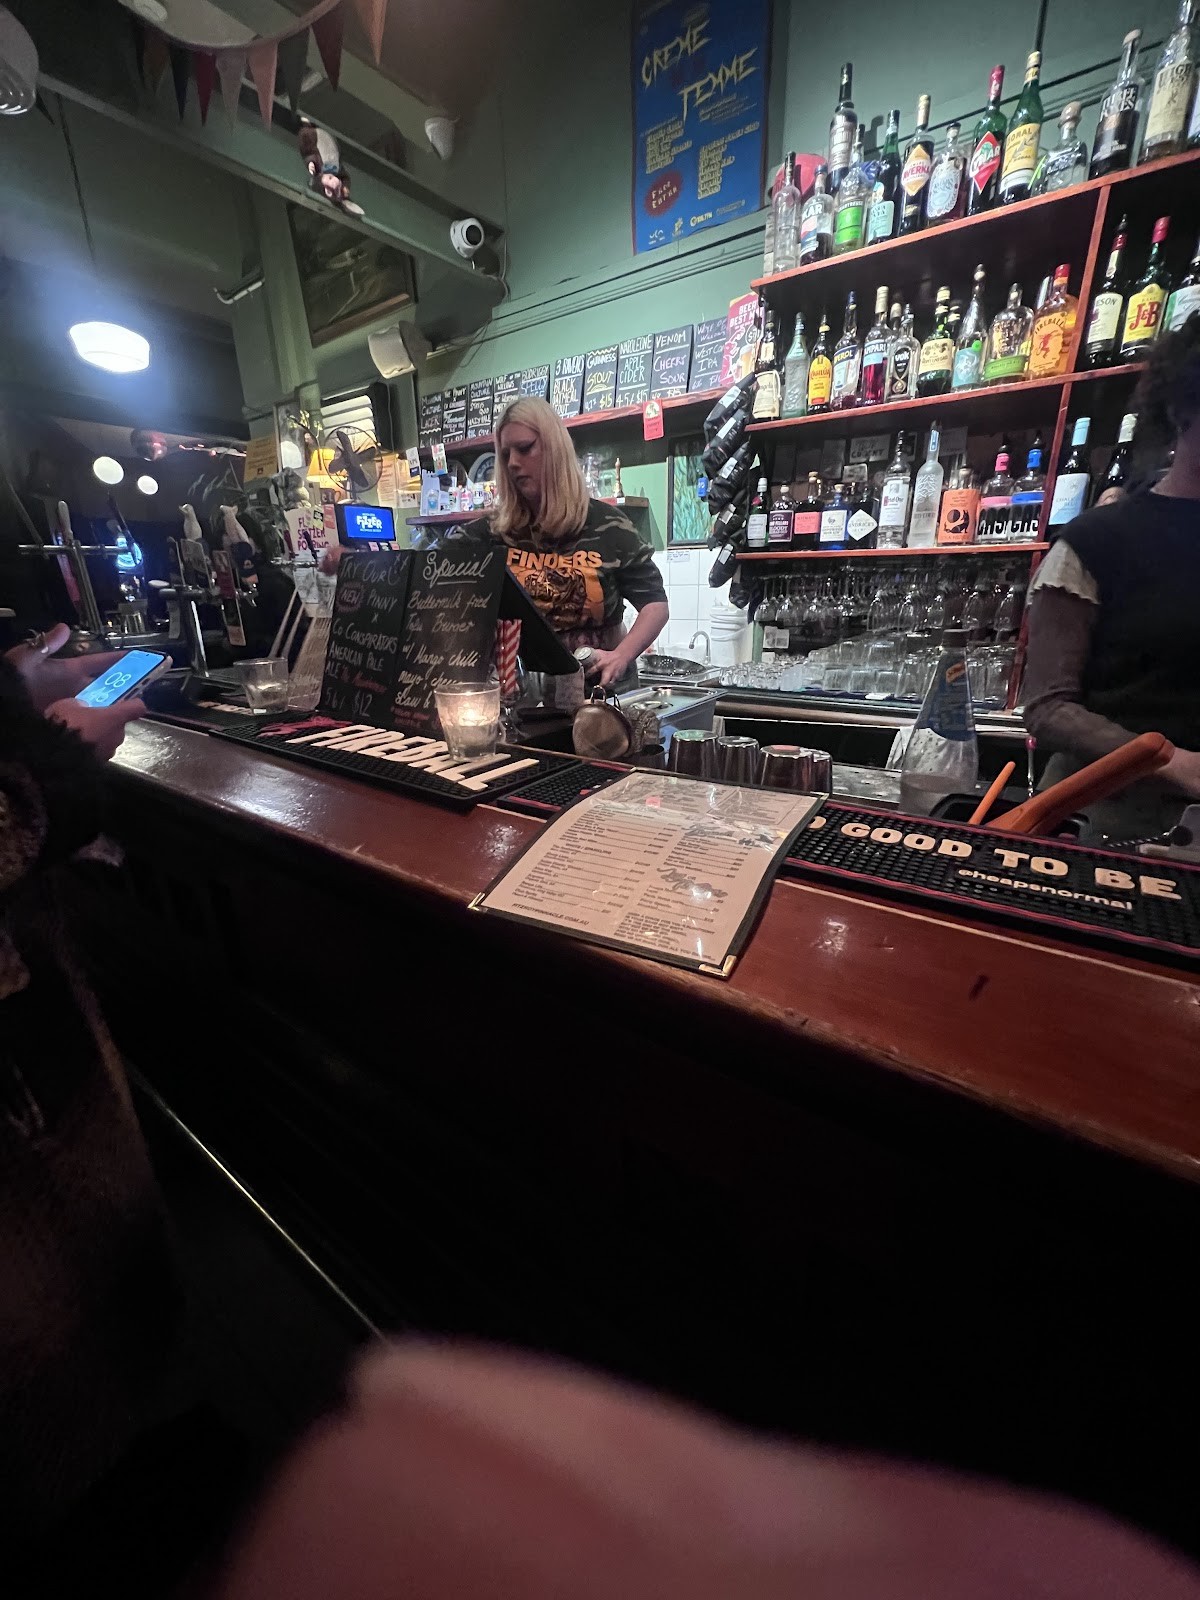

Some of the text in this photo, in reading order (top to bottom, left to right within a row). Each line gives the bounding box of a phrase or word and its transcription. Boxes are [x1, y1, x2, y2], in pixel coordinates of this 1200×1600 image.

[1129, 301, 1162, 330] J&B
[656, 330, 686, 348] VENOM
[587, 353, 617, 369] GUINNESS
[624, 355, 645, 371] APPLE
[653, 355, 687, 372] CHERRY
[697, 357, 718, 372] IPA
[587, 371, 614, 392] STOUT
[620, 367, 645, 384] CIDER
[660, 372, 685, 385] SOUR
[554, 377, 576, 395] BLACK
[599, 393, 613, 410] $15
[356, 515, 383, 529] FIZZER
[297, 541, 329, 551] PORING
[506, 548, 603, 570] FINDERS
[341, 556, 387, 583] TRY OUR
[423, 551, 494, 588] Special
[341, 588, 398, 613] NEW PINNY
[407, 590, 493, 618] Buttermilk fried
[405, 612, 475, 641] Tofu Burger
[329, 640, 385, 672] AMERICAN PALE
[413, 644, 444, 679] Mango
[448, 649, 481, 667] chilli
[105, 671, 132, 688] 08
[325, 660, 341, 680] ALE
[284, 724, 540, 791] FIREBALL
[840, 822, 973, 858] GOOD
[993, 847, 1069, 876] TO
[1094, 866, 1182, 900] BE
[957, 868, 1133, 911] @heapsnormal
